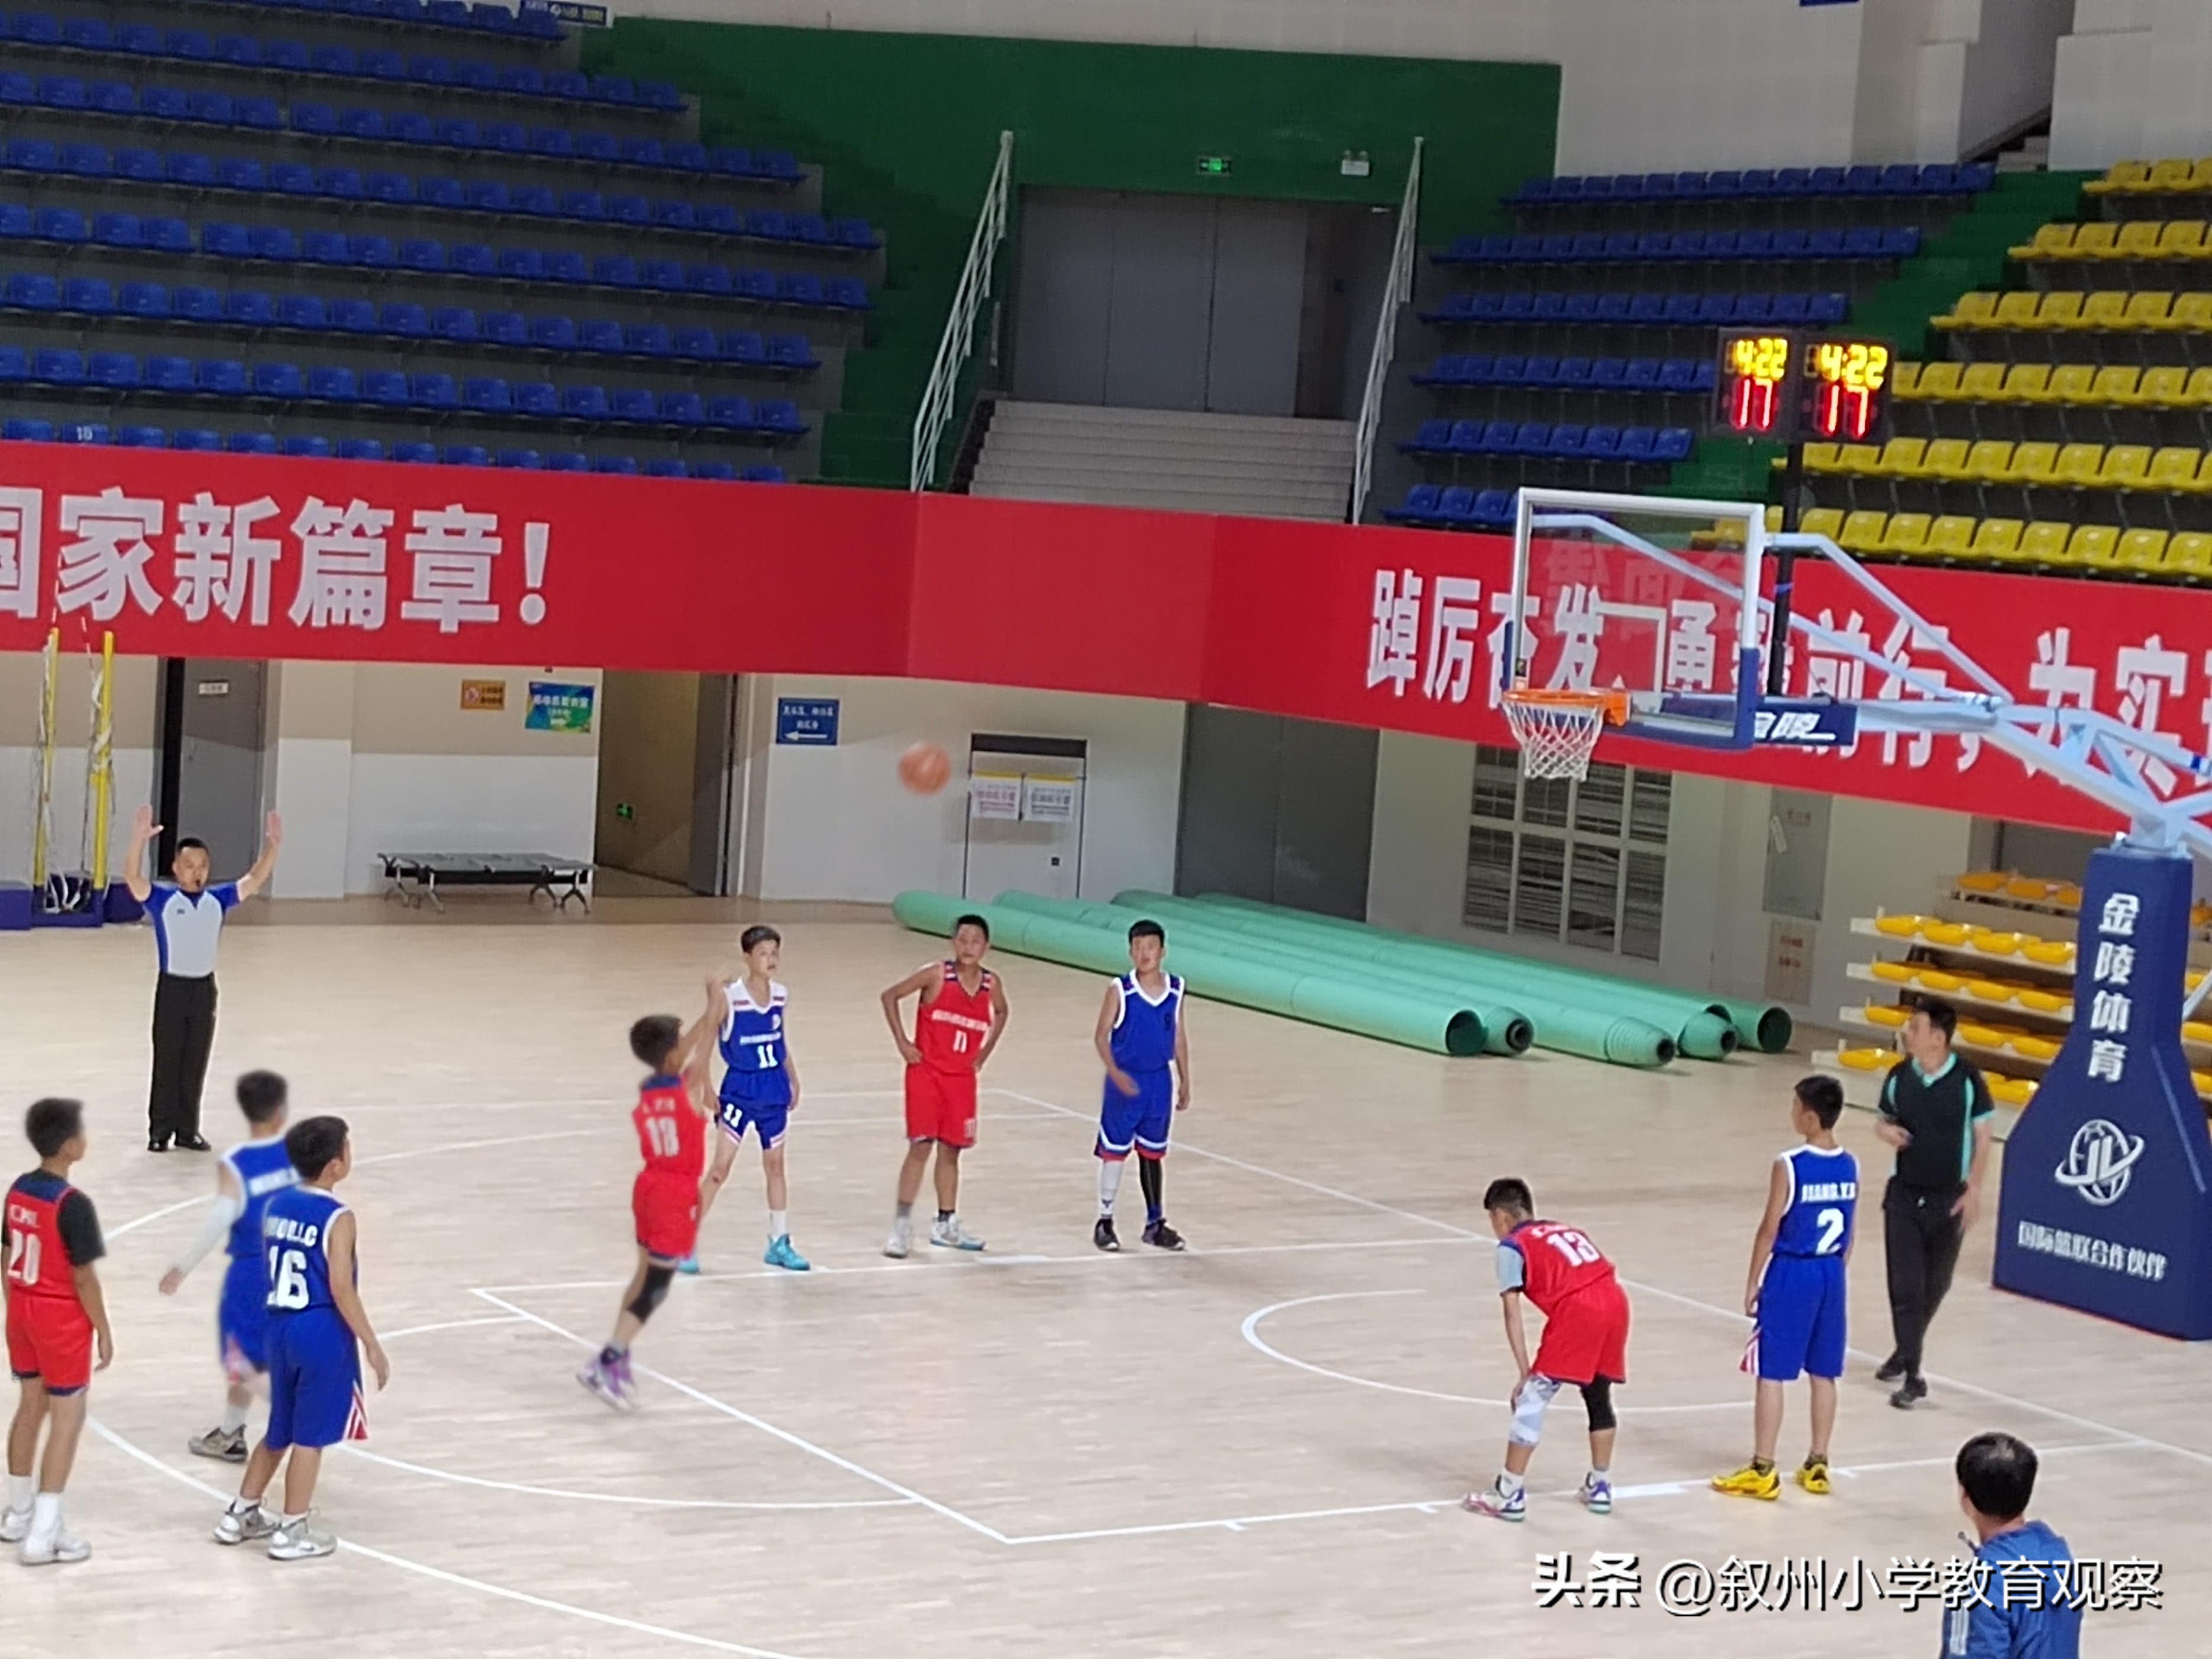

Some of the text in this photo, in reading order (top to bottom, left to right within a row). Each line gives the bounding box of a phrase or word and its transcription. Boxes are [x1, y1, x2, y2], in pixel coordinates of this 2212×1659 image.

[1736, 338, 1788, 380] 4:22
[1820, 343, 1888, 389] 4:22
[1733, 377, 1774, 429] 17
[1823, 384, 1871, 437] 17
[2087, 893, 2140, 1083] 金陵体育
[757, 1044, 778, 1069] 11
[724, 1103, 742, 1128] 11
[1546, 1231, 1600, 1267] 13
[1816, 1208, 1844, 1255] 2
[2017, 1219, 2167, 1282] 国际篮联合作伙伴
[7, 1228, 41, 1286] 20
[266, 1245, 309, 1309] 16
